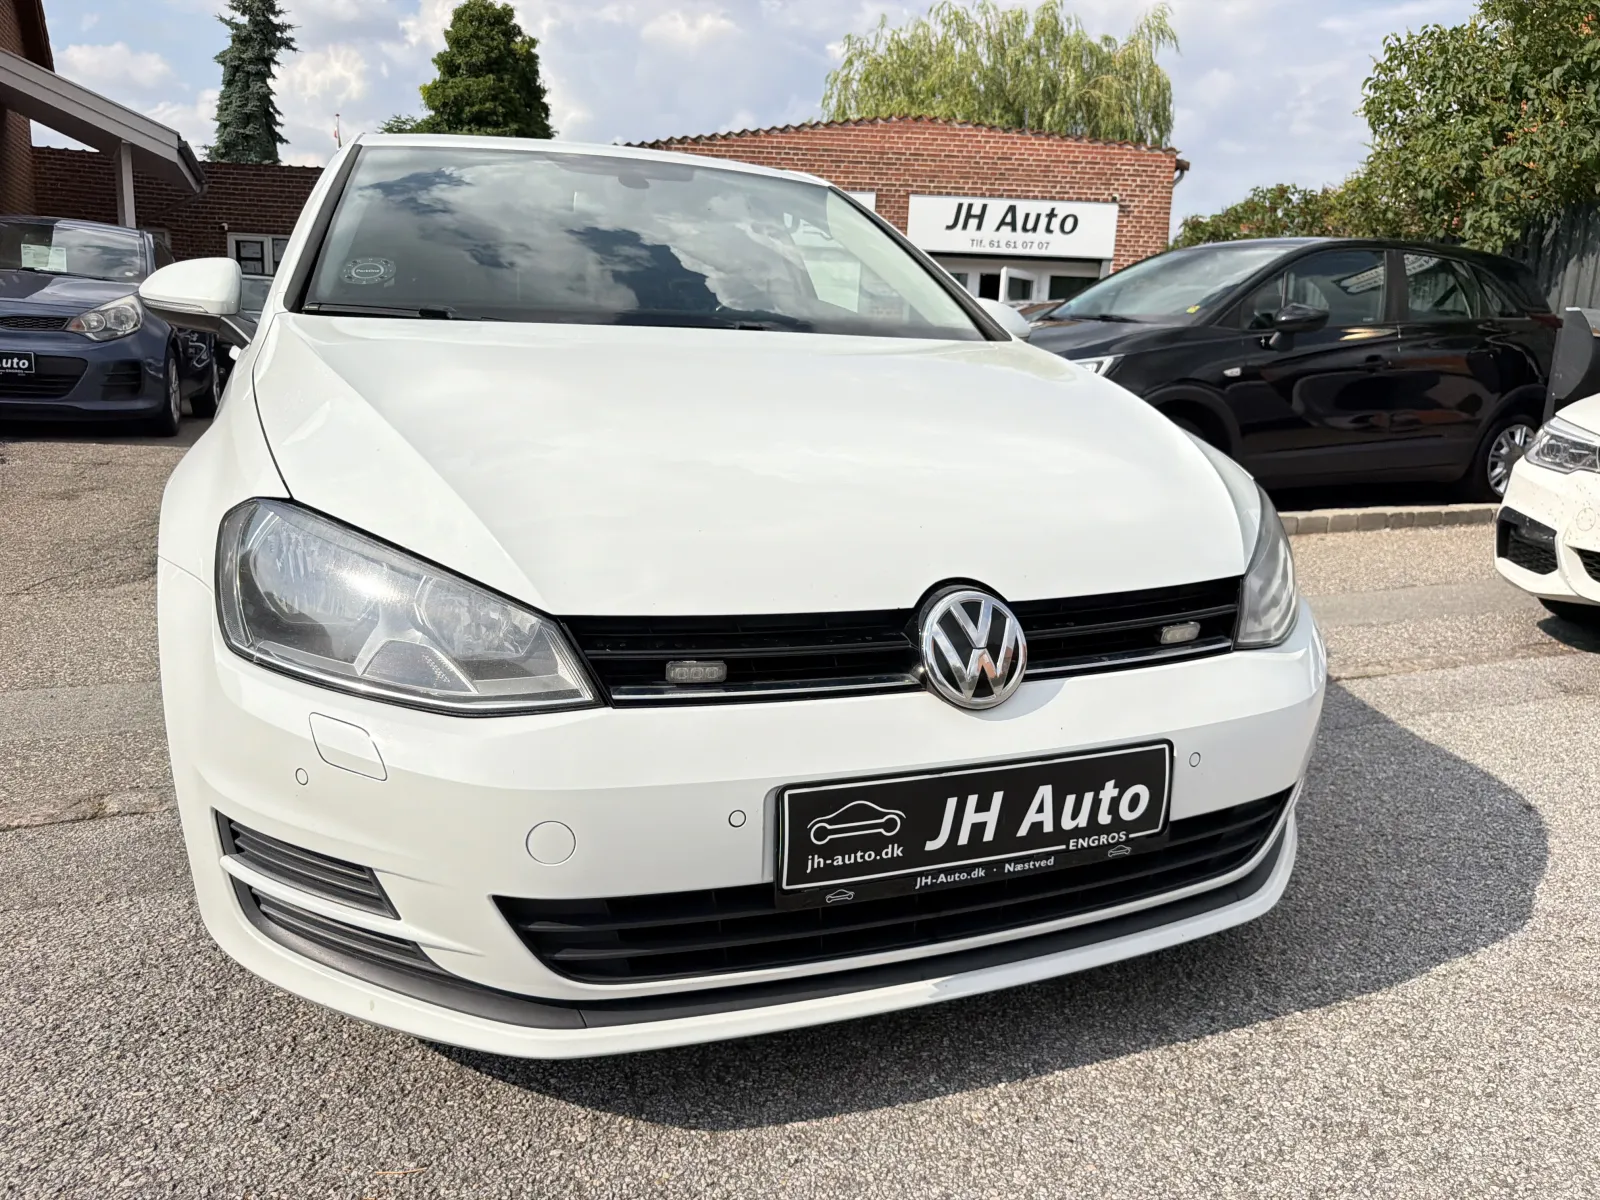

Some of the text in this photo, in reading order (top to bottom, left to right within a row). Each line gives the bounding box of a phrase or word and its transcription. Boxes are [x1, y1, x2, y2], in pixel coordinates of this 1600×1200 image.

[945, 202, 1079, 235] JH Auto
[970, 238, 1051, 251] Tlf. 61 61 07 07
[0, 357, 29, 369] uto
[924, 779, 1150, 851] JH Auto
[1068, 831, 1127, 850] ENGROS
[806, 843, 904, 874] jh-auto.dk
[915, 856, 1055, 889] JH-Auto.dk Næstved
